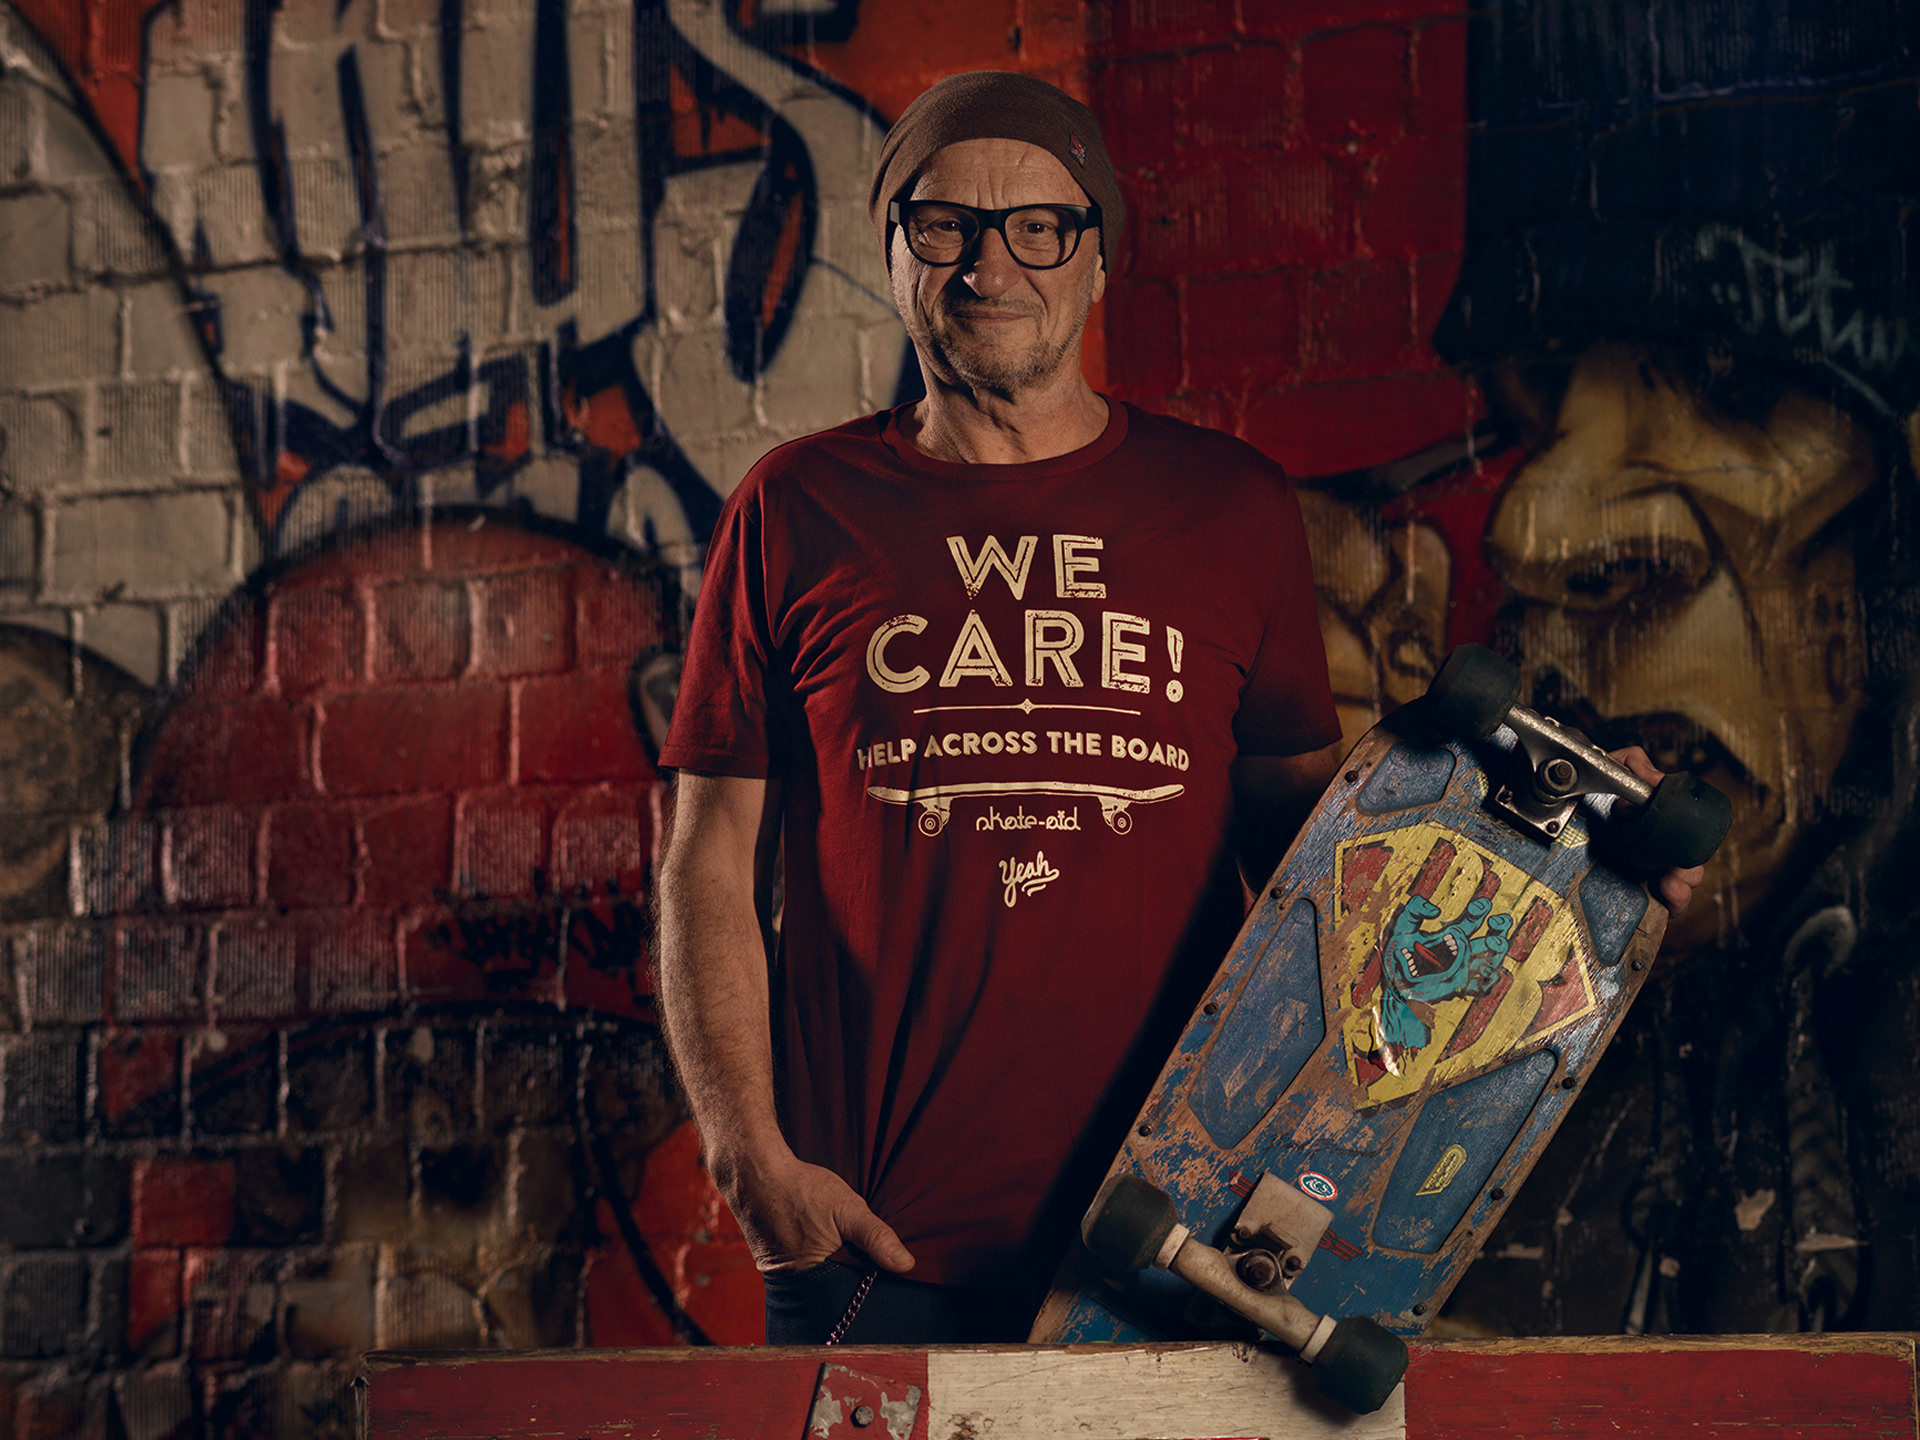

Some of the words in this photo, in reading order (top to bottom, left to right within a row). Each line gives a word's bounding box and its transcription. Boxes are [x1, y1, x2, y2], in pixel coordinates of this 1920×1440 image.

[947, 535, 1106, 600] WE
[866, 609, 1184, 703] CARE!
[857, 739, 916, 769] HELP
[924, 731, 1037, 757] ACROSS
[1047, 731, 1101, 755] THE
[1112, 735, 1189, 771] BOARD
[999, 851, 1059, 907] Yeah
